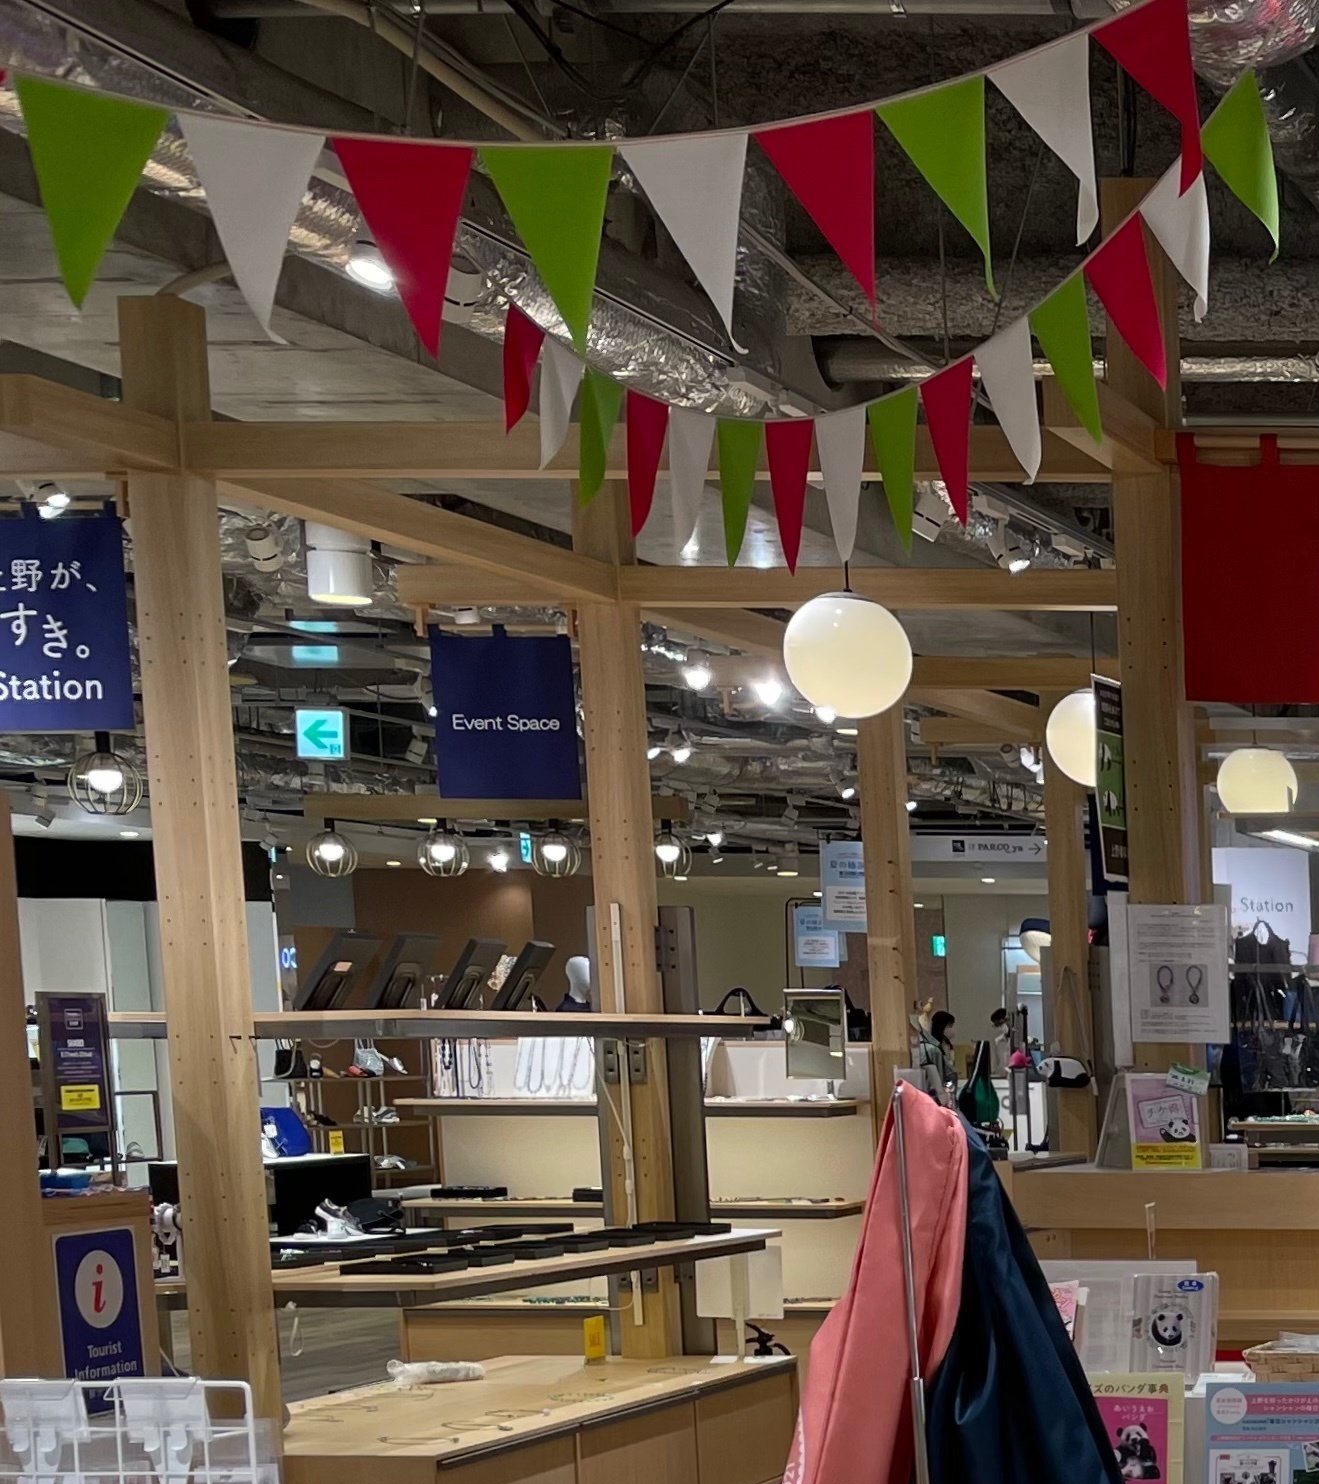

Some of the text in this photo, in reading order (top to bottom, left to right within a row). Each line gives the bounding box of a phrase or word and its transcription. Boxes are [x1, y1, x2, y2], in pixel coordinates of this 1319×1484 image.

[0, 602, 91, 658] すき。
[452, 714, 561, 733] Event Space
[1240, 896, 1294, 913] Station
[87, 1341, 122, 1358] Tourist
[74, 1359, 138, 1381] Information
